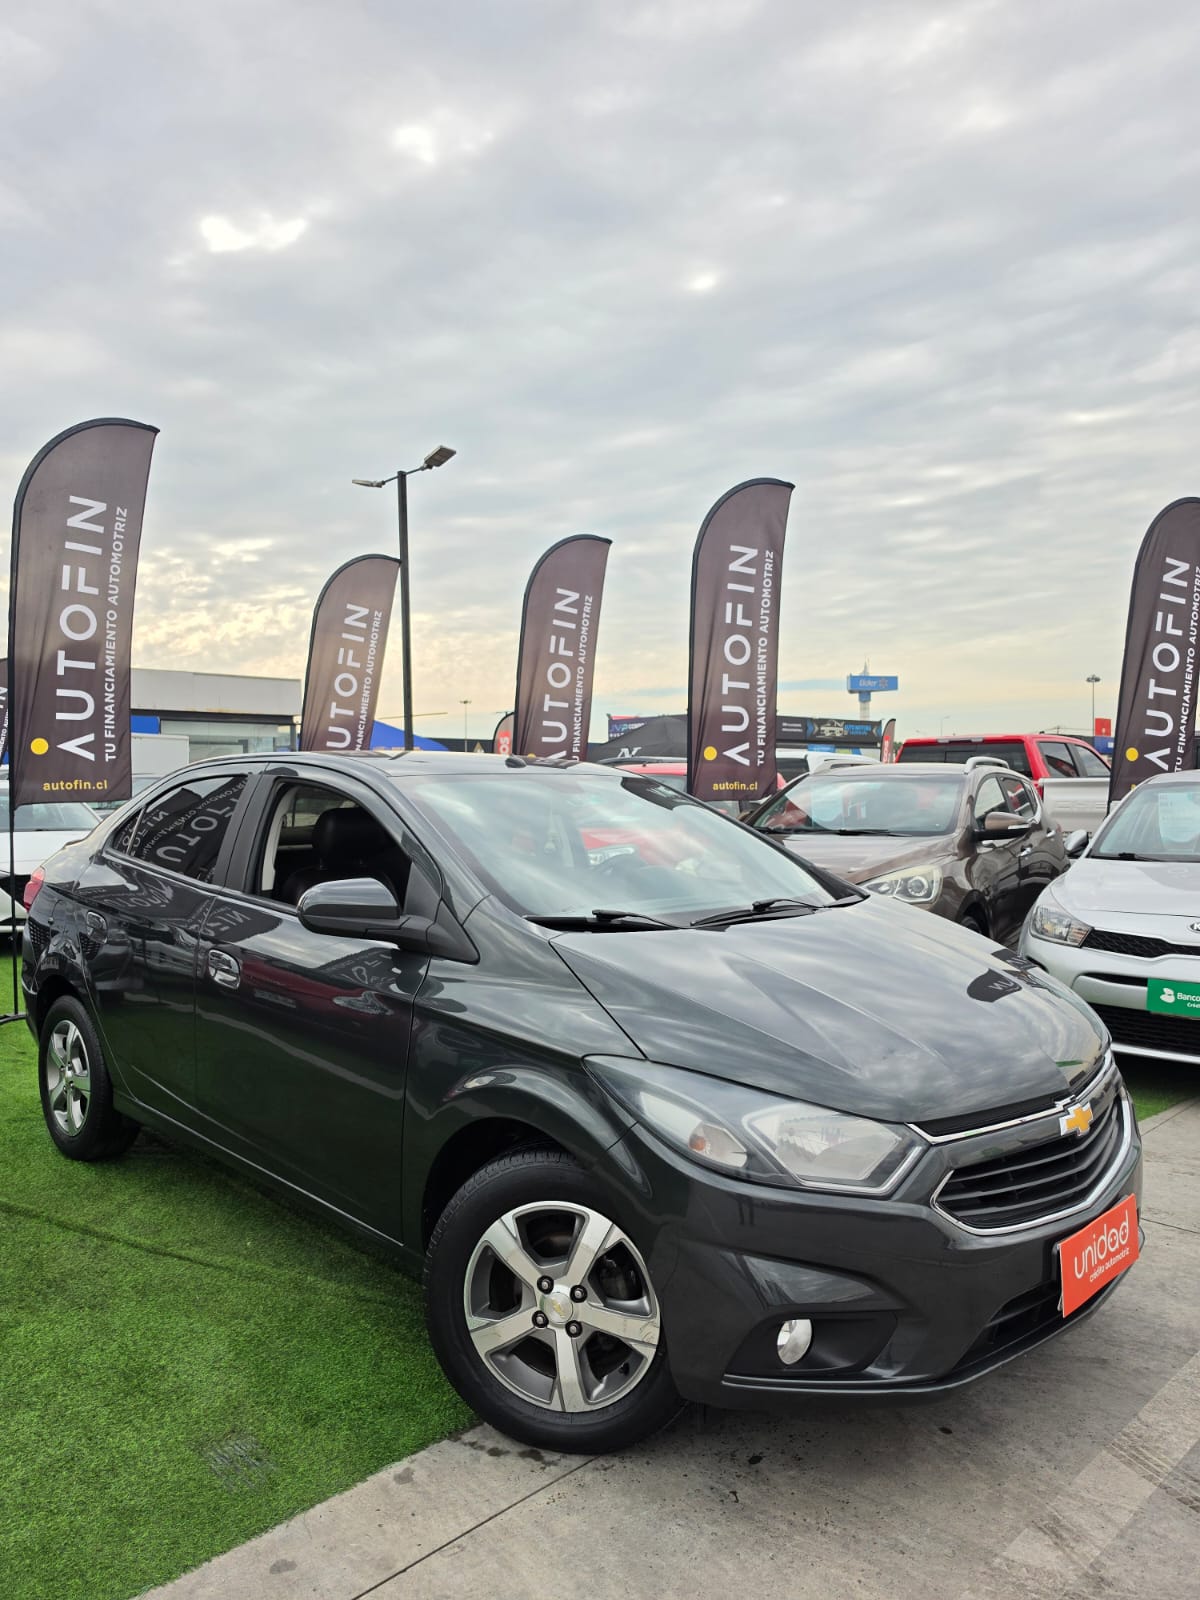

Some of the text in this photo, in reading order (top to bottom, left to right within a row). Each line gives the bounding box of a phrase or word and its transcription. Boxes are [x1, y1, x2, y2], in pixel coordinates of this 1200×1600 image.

[56, 495, 107, 762] AUTOFIN
[104, 506, 128, 762] TU FINANCIAMIENTO AUTOMOTRIZ
[326, 603, 370, 749] UTOFIN
[355, 610, 383, 751] NANCIAMIENTO AUTOMOTRIZ
[578, 595, 593, 664] AUTOMOTRIZ
[721, 545, 758, 767] AUTOFIN
[756, 550, 774, 767] TU FINANCIAMIENTO AUTOMOTRIZ
[1144, 557, 1190, 771] AUTOFIN
[572, 666, 585, 753] FINANCIAMIENTO
[1177, 648, 1196, 754] FINANCIAMIENTO
[43, 779, 109, 791] autofin.cl
[712, 781, 758, 791] autofin.cl
[1174, 757, 1183, 773] TU
[1074, 1209, 1129, 1279] unidad
